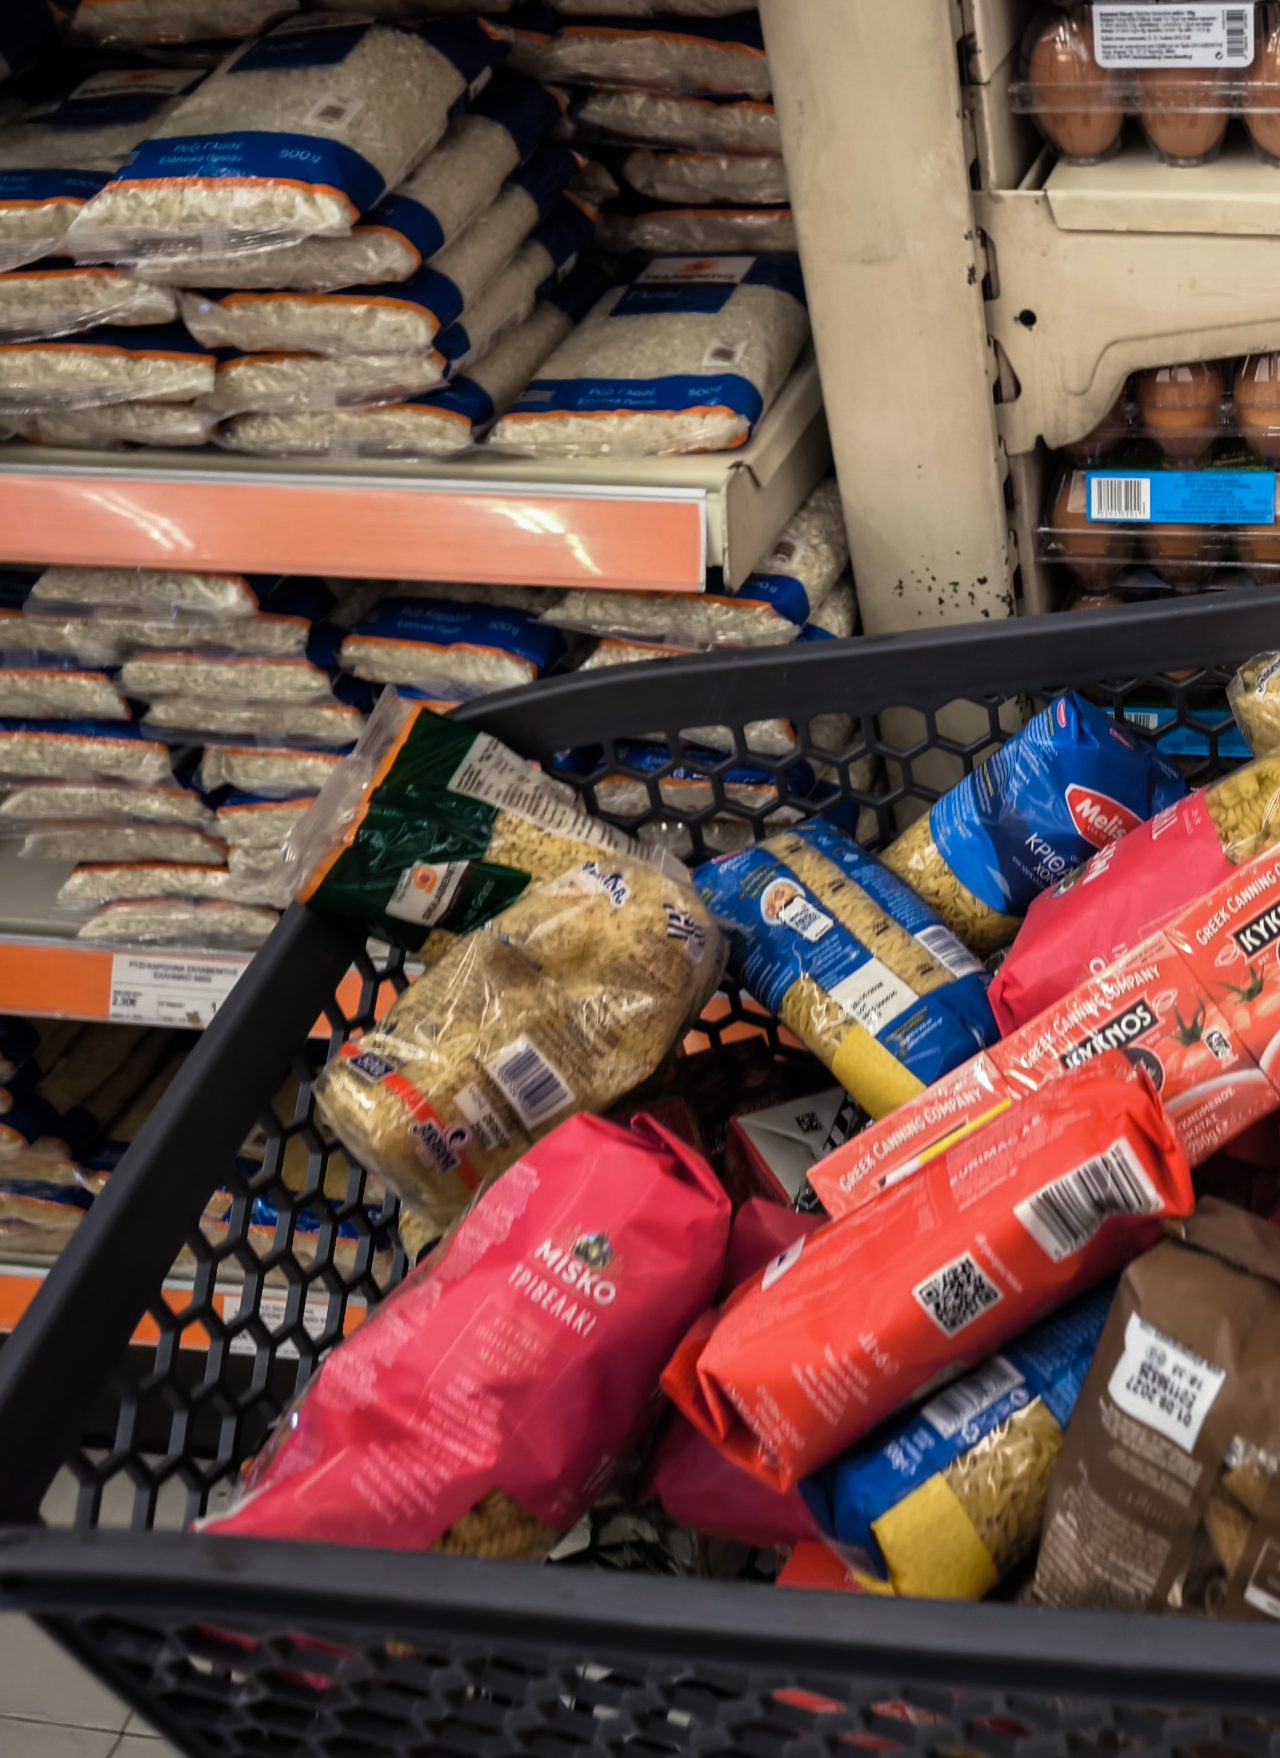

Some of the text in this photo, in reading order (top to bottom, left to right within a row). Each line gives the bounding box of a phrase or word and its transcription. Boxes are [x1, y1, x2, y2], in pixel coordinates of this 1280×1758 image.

[1075, 797, 1127, 842] Melis
[1024, 832, 1075, 878] ΚΡΙΘΑ
[1033, 862, 1056, 884] ΧΟΝ
[1195, 907, 1231, 946] GREEK
[1226, 869, 1277, 914] CANNING
[1020, 1030, 1057, 1069] GREEK
[839, 1087, 983, 1193] GREEK CANNING COMPANY
[507, 1261, 598, 1339] ΤΡΙΒΕΛΑΚΙ
[534, 1237, 617, 1306] MISKO
